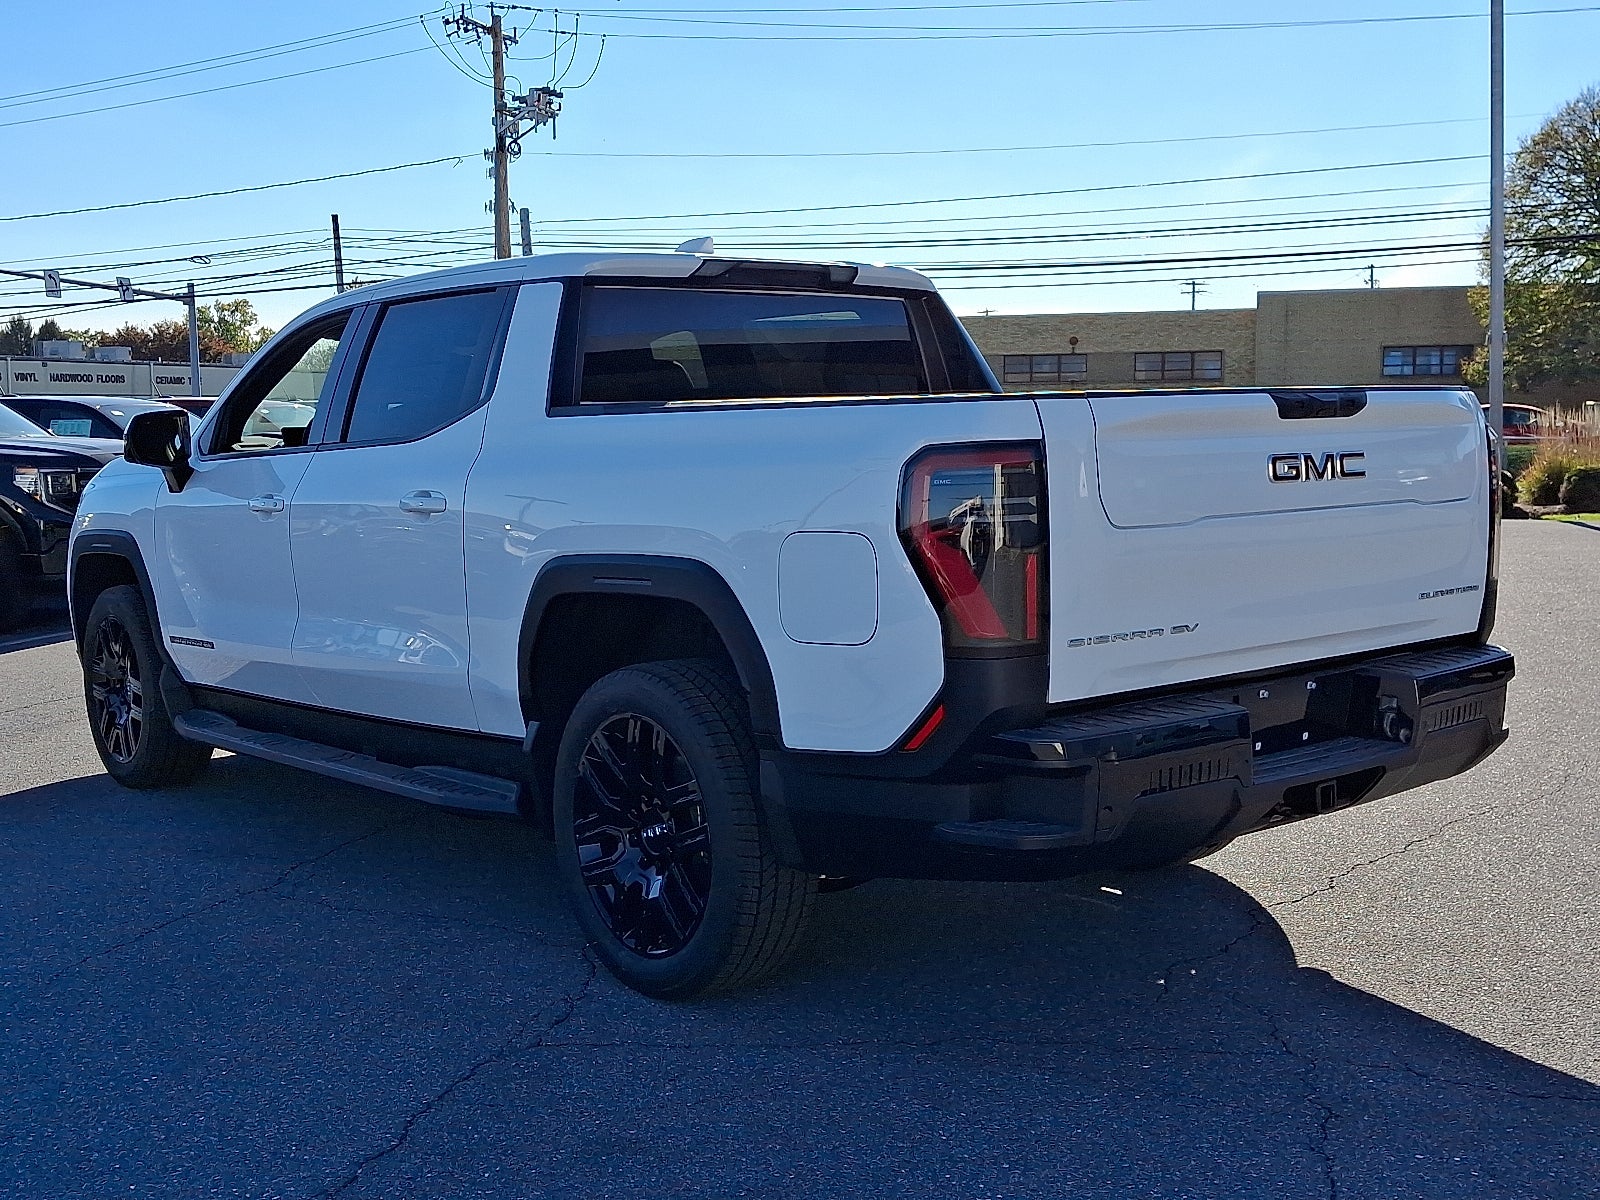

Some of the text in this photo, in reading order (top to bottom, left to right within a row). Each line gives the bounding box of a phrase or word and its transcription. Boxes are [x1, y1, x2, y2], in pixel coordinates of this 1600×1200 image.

[14, 372, 39, 382] VINYL
[49, 373, 126, 384] HARDWOOD FLOORS
[155, 376, 186, 385] CERAMIC
[1267, 450, 1367, 484] GMC
[1066, 622, 1200, 648] SIERRA EV
